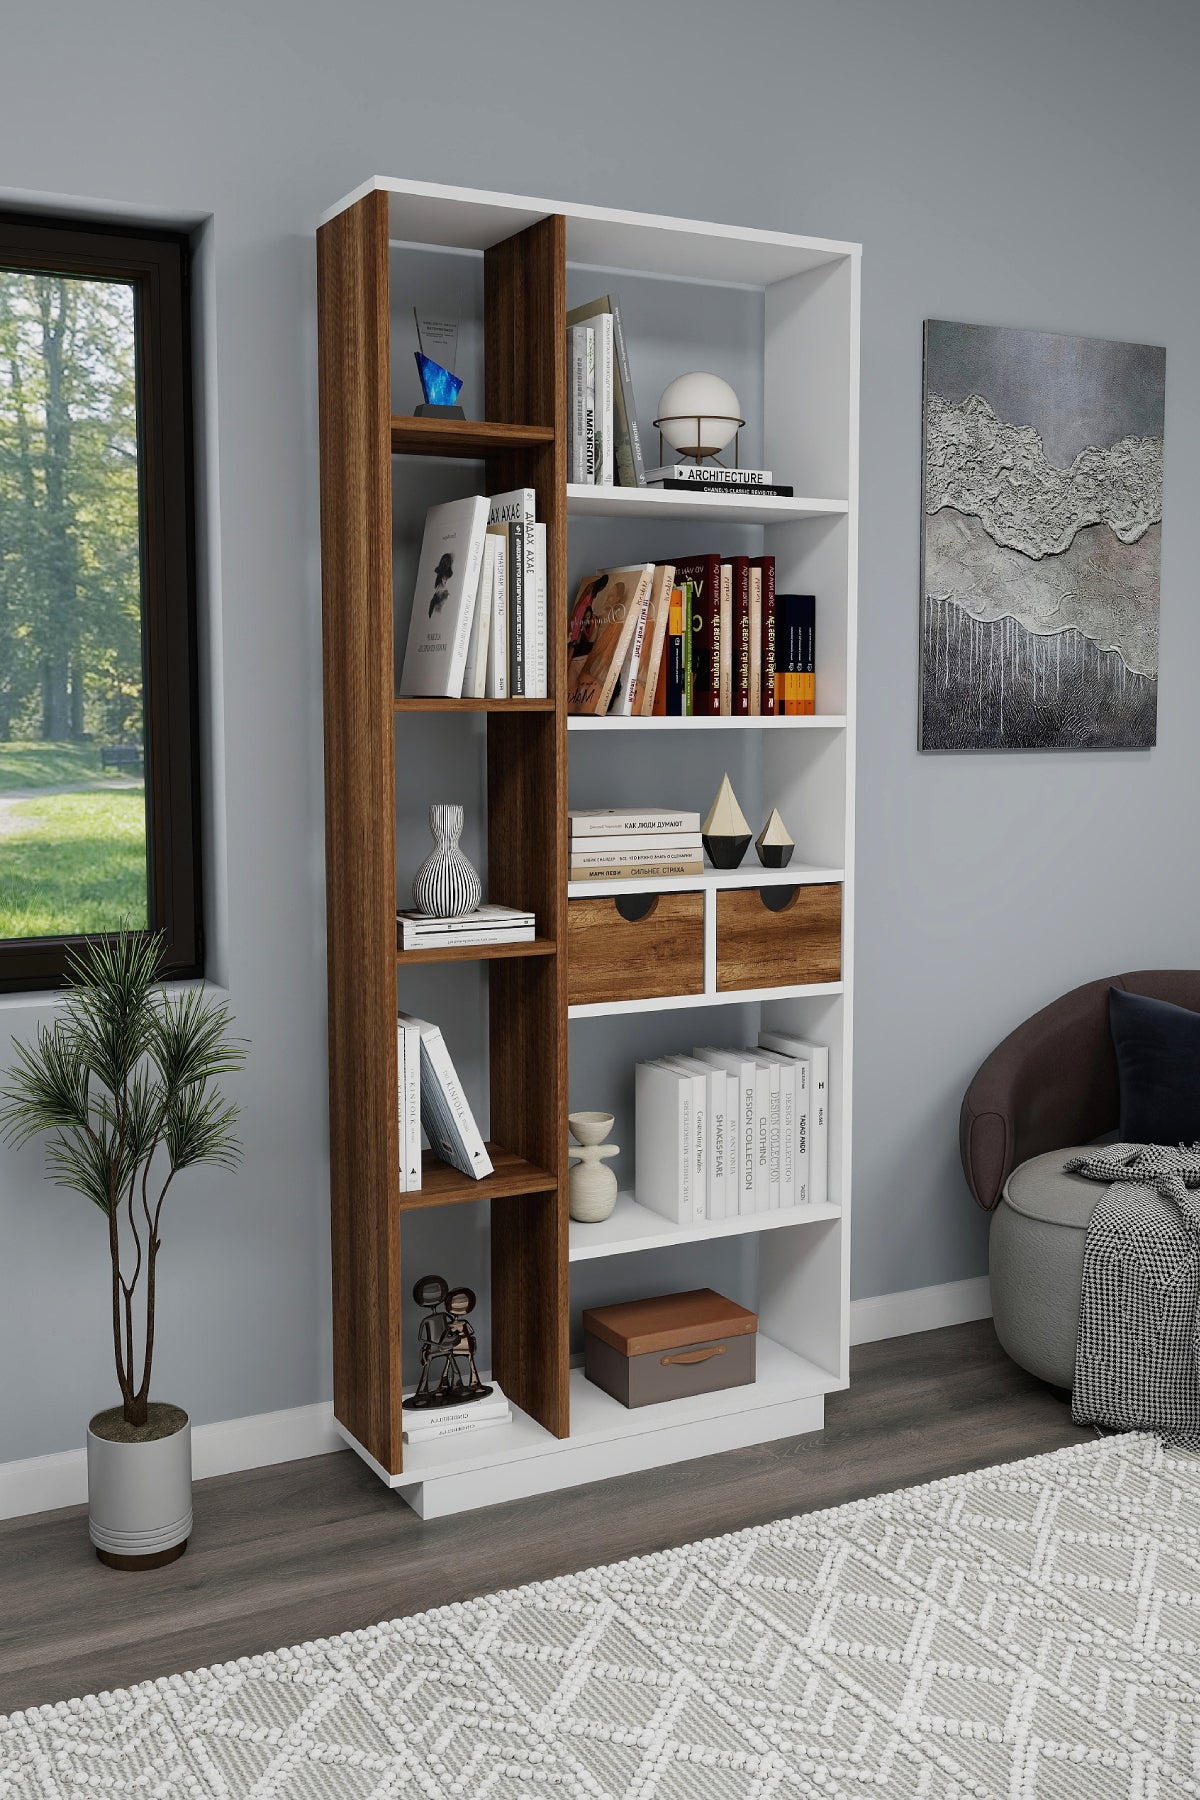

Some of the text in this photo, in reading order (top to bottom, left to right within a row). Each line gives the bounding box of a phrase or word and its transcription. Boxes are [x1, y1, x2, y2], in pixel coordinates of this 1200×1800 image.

[688, 469, 763, 484] ARCHITECTURE
[771, 1092, 779, 1183] DESIGN COLLECTION
